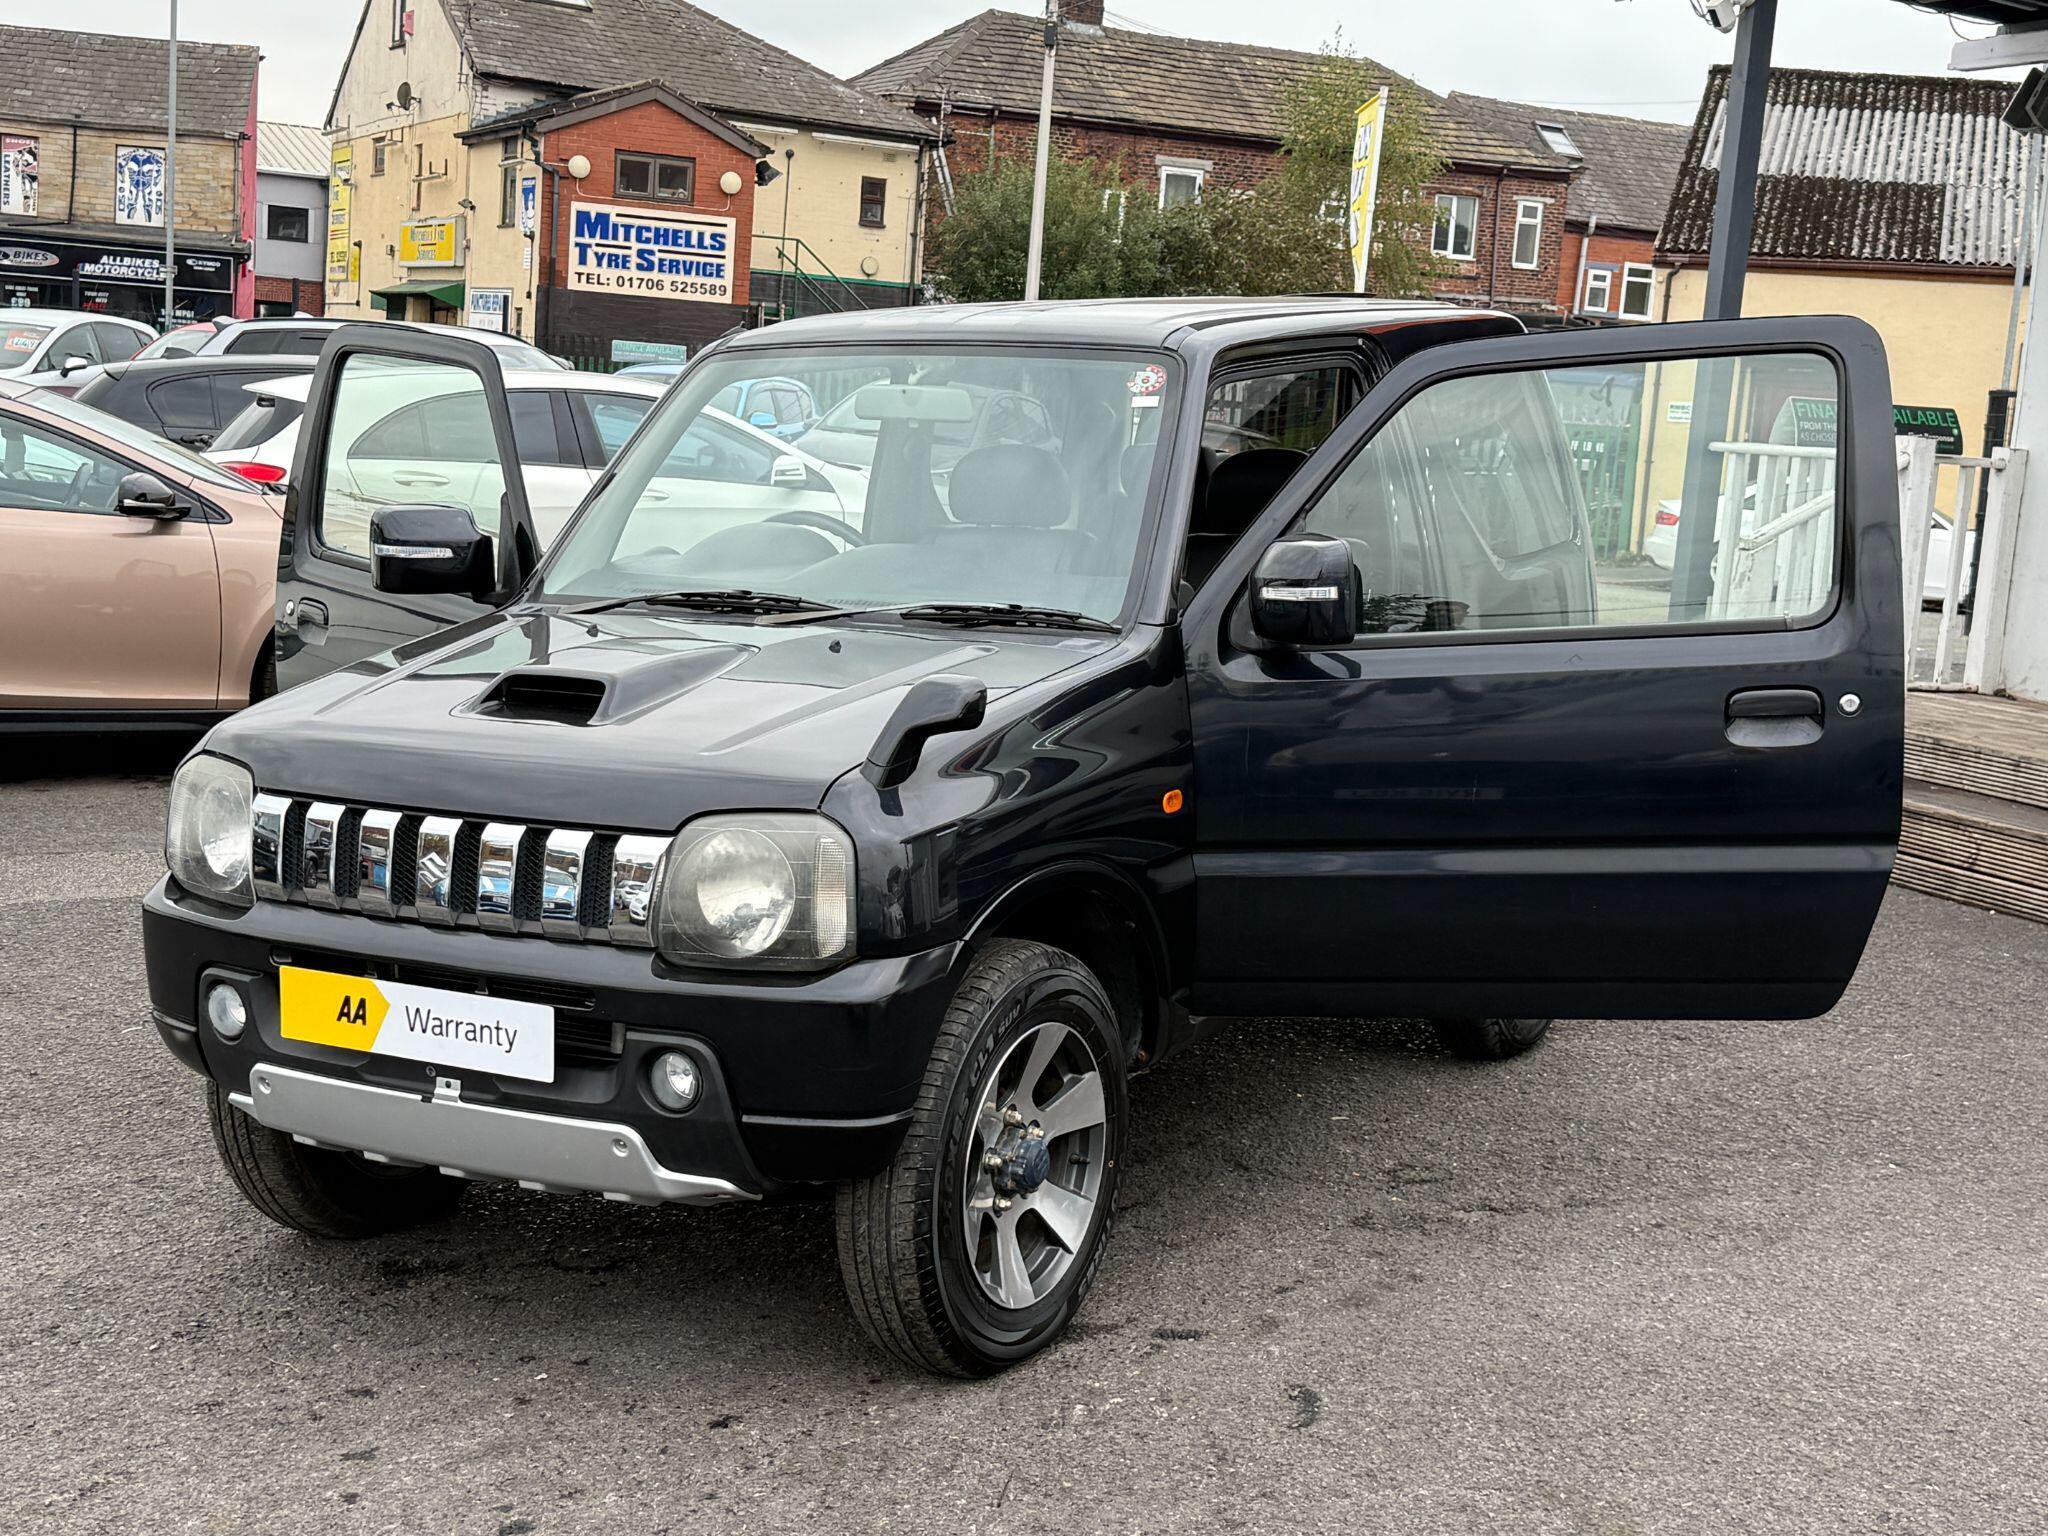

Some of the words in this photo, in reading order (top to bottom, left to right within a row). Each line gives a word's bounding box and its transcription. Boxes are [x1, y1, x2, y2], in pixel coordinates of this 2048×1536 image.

[3, 153, 11, 206] LEATHERS
[574, 210, 727, 251] MITCHELLS
[13, 250, 49, 261] BIKES
[100, 255, 160, 268] ALLBIKES
[574, 242, 632, 270] TYRE
[636, 248, 725, 279] SERVICE
[574, 272, 611, 287] TEL:
[616, 275, 665, 291] 01706
[670, 281, 728, 297] 525589
[1794, 403, 1837, 418] FINA
[1893, 408, 1958, 427] AILABLE
[1800, 421, 1822, 431] FROM
[336, 995, 367, 1026] AA
[405, 1005, 517, 1053] Warranty
